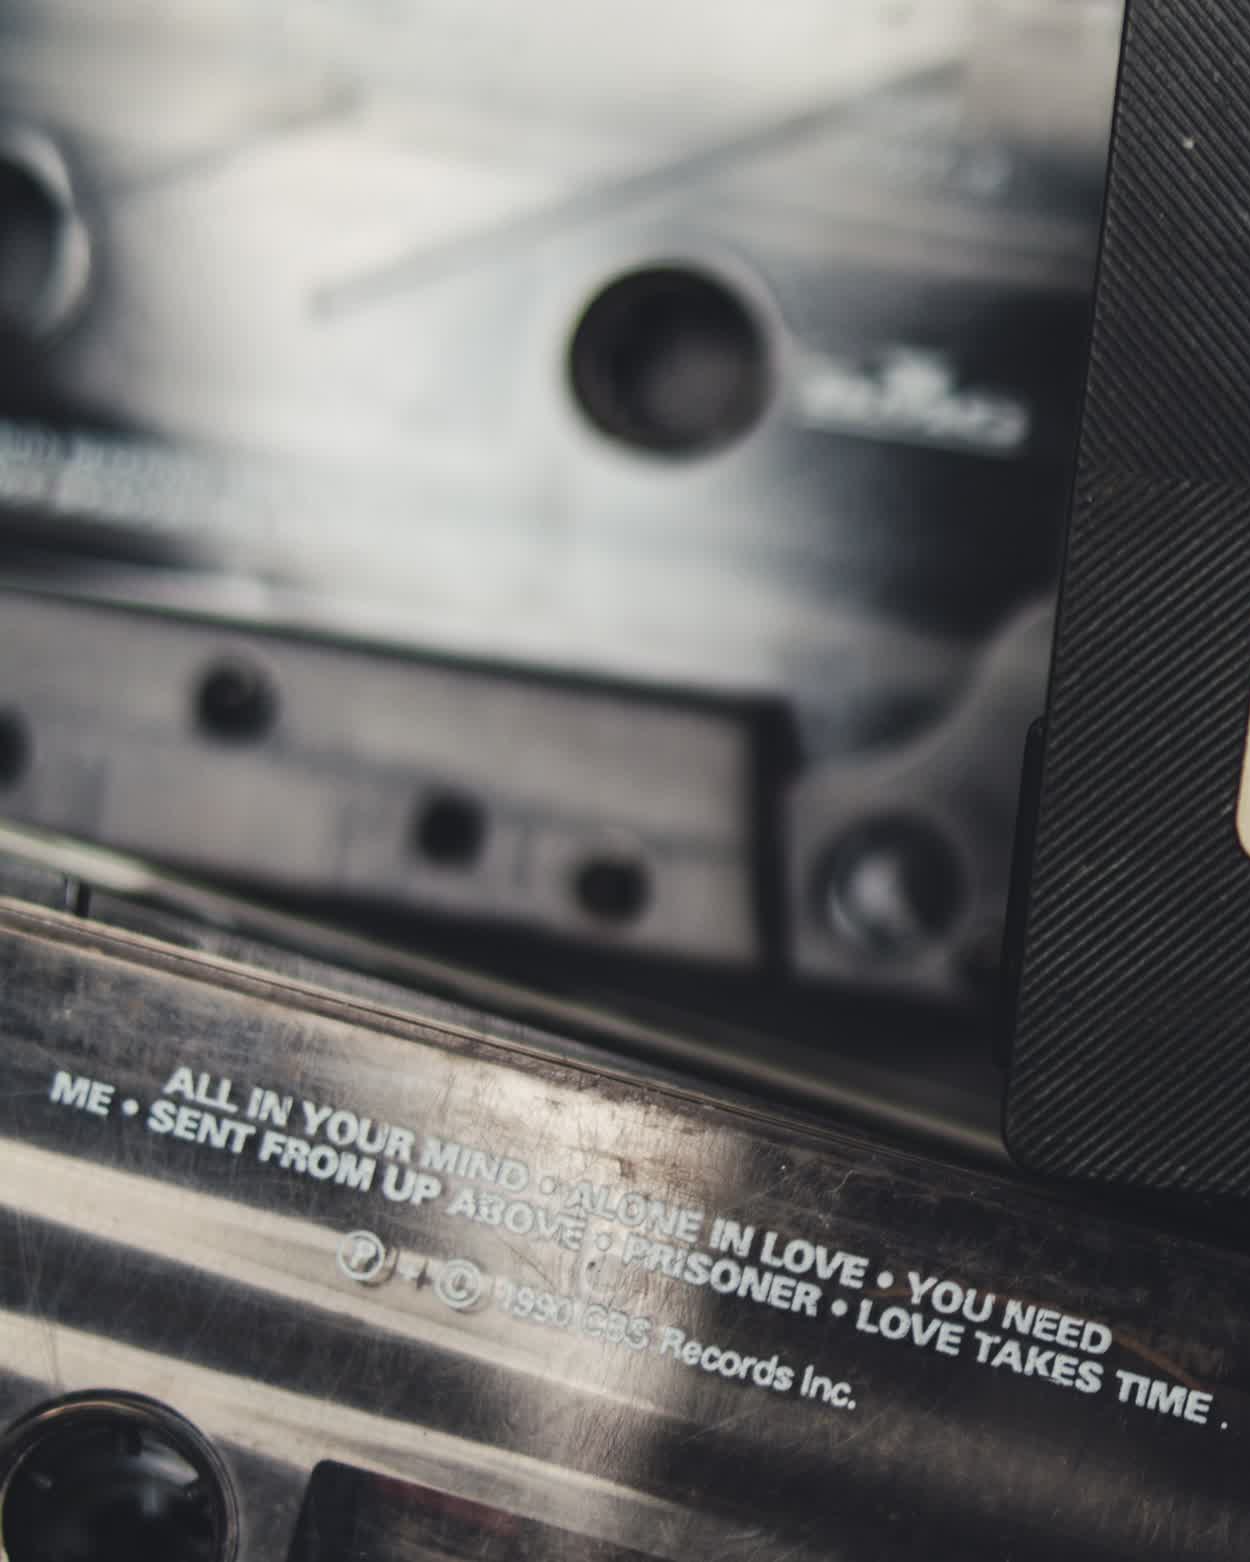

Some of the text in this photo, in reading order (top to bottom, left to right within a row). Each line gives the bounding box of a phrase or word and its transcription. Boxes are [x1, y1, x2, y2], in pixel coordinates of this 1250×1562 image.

[50, 1072, 115, 1116] ME
[148, 1099, 256, 1153] SENT
[258, 1131, 376, 1192] FROM
[382, 1167, 442, 1206] UP
[448, 1190, 588, 1250] ABOVE
[623, 1232, 822, 1317] PRISONER
[856, 1301, 964, 1356] LOVE
[975, 1332, 1104, 1394] TAKES
[164, 1066, 1112, 1355] ALL IN YOUR MIND ALONE IN LOVE YOU NEED
[580, 1303, 654, 1350] CBS
[659, 1327, 794, 1392] Records
[801, 1365, 856, 1409] Inc.
